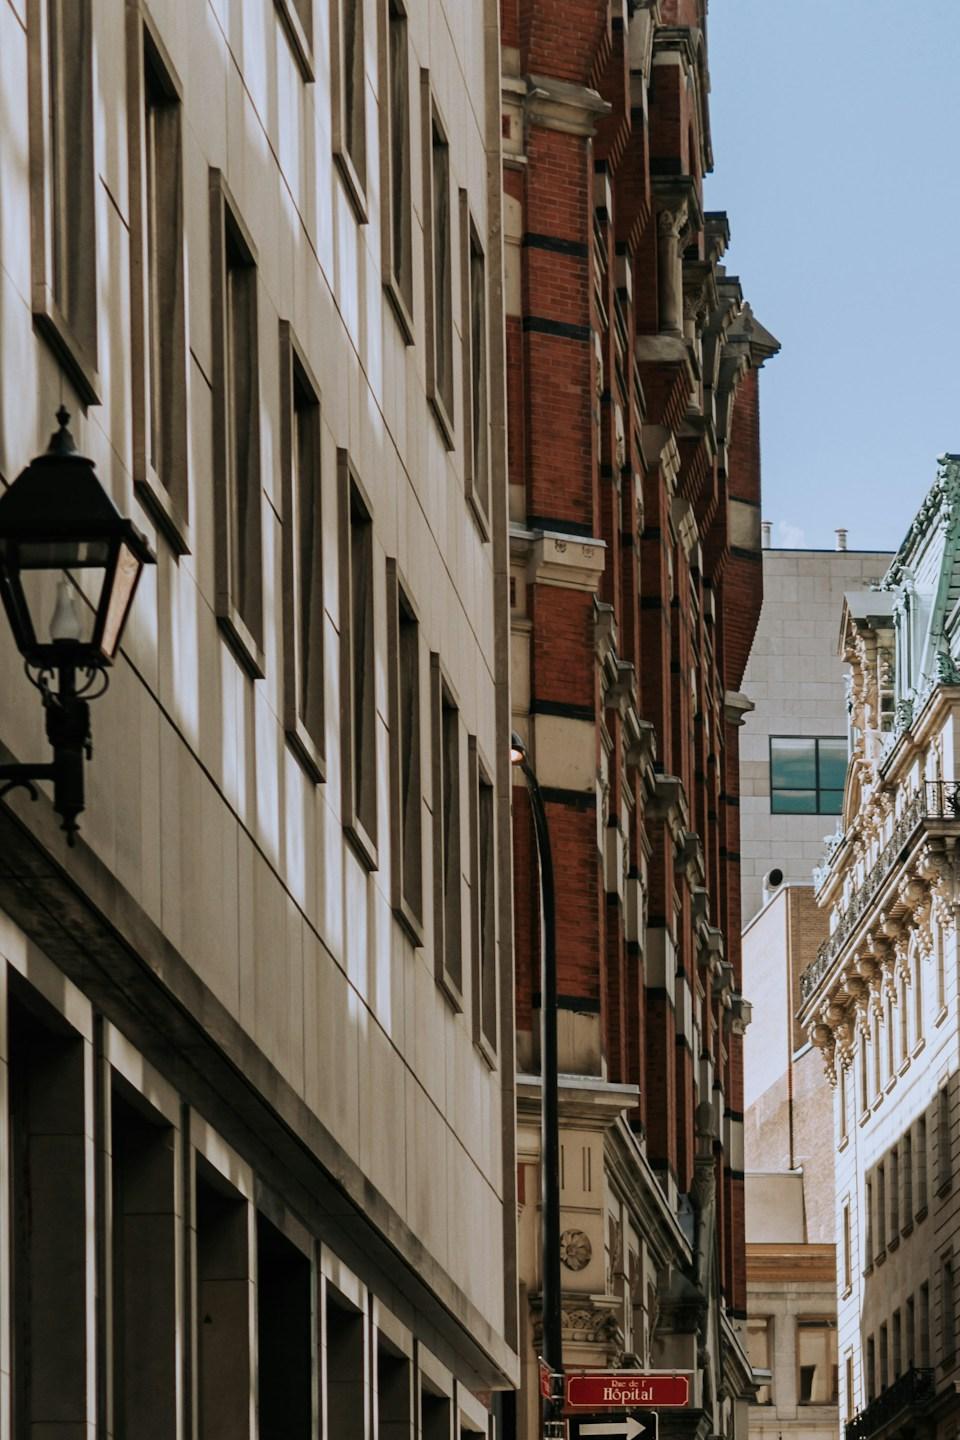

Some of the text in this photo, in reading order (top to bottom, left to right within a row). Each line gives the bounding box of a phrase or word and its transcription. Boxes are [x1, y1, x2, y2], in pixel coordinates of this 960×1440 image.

[611, 1380, 627, 1388] Rue
[628, 1380, 639, 1388] de
[603, 1387, 653, 1405] Hôpital
